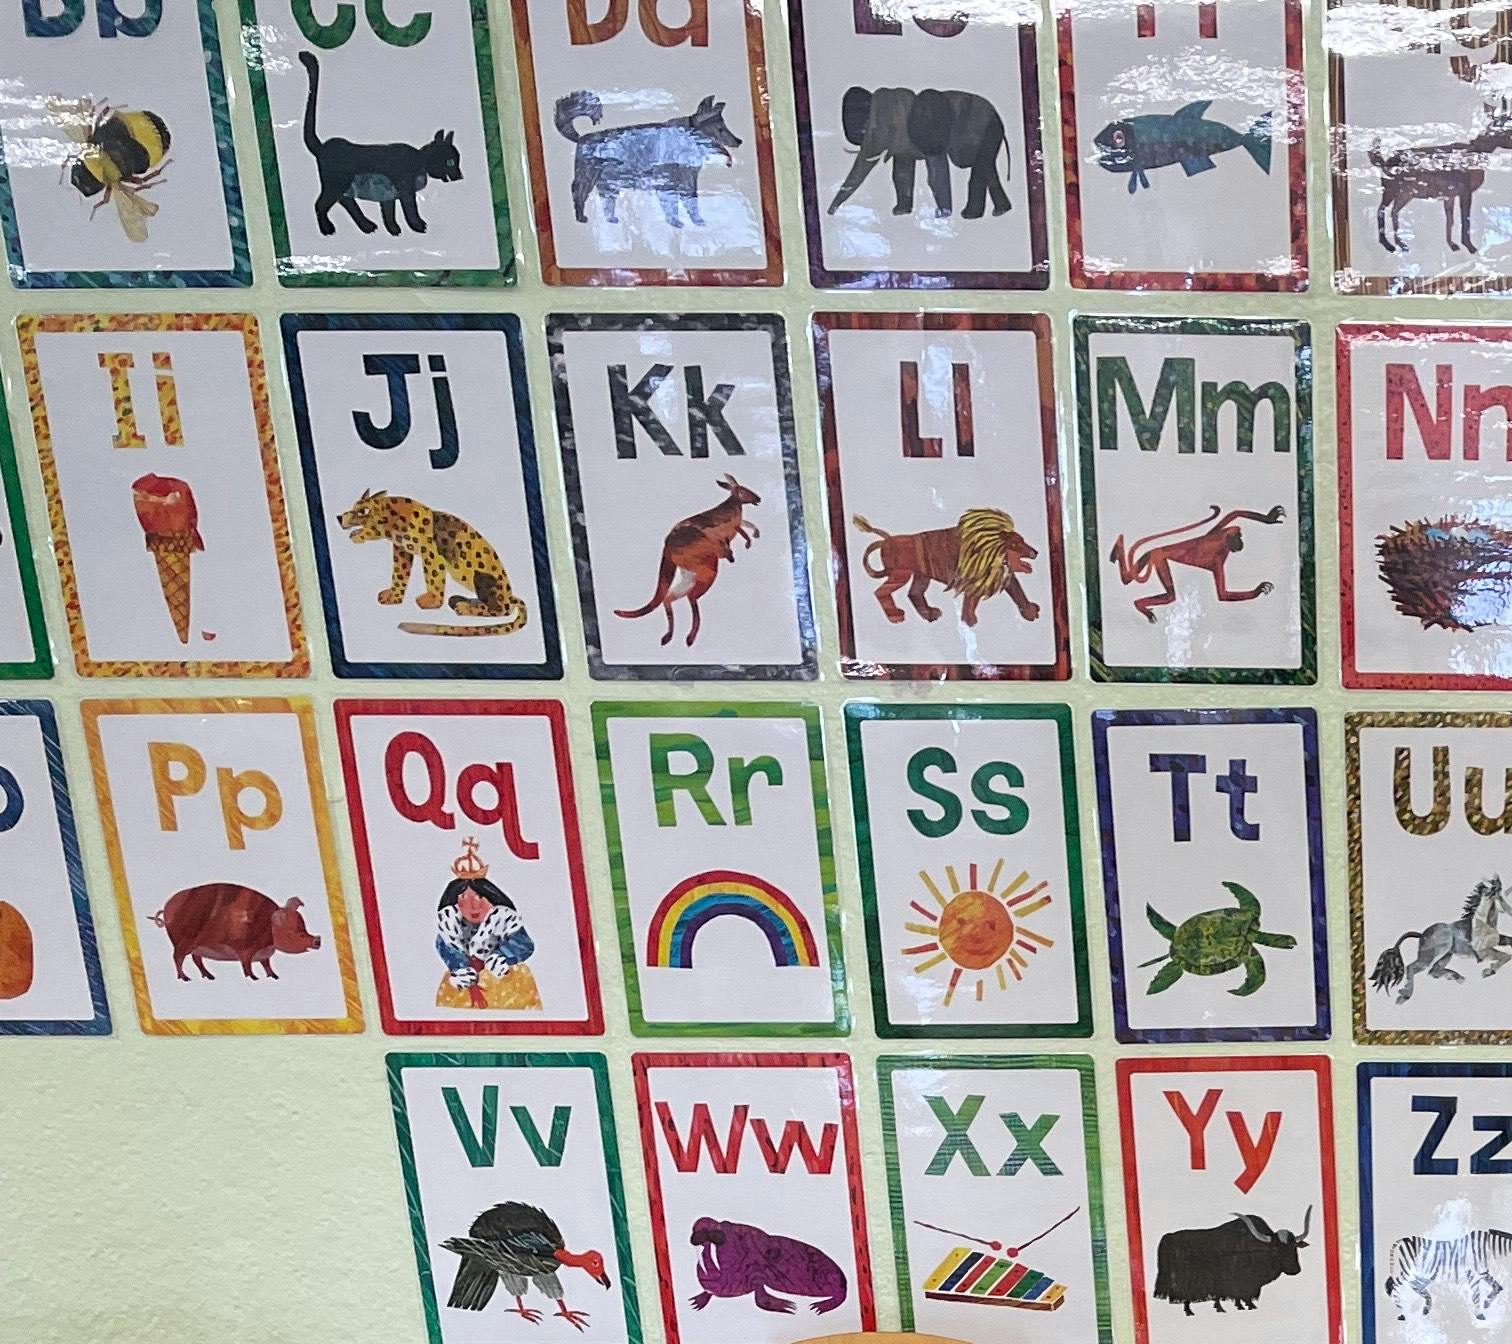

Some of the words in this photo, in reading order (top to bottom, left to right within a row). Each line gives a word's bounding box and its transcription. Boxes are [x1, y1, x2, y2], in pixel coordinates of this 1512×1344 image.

[98, 352, 184, 449] Ii
[352, 354, 460, 469] Jj
[607, 364, 746, 459] Kk
[900, 361, 975, 458] Ll
[1096, 356, 1291, 455] Mm
[147, 742, 283, 850] Pp
[384, 731, 540, 860] Qq
[649, 733, 783, 827] Rr
[906, 747, 1029, 838] Ss
[1149, 753, 1260, 842] Tt
[441, 1085, 572, 1168] Vv
[654, 1101, 838, 1174] Ww
[922, 1095, 1064, 1176] Xx
[1162, 1088, 1283, 1195] Yy
